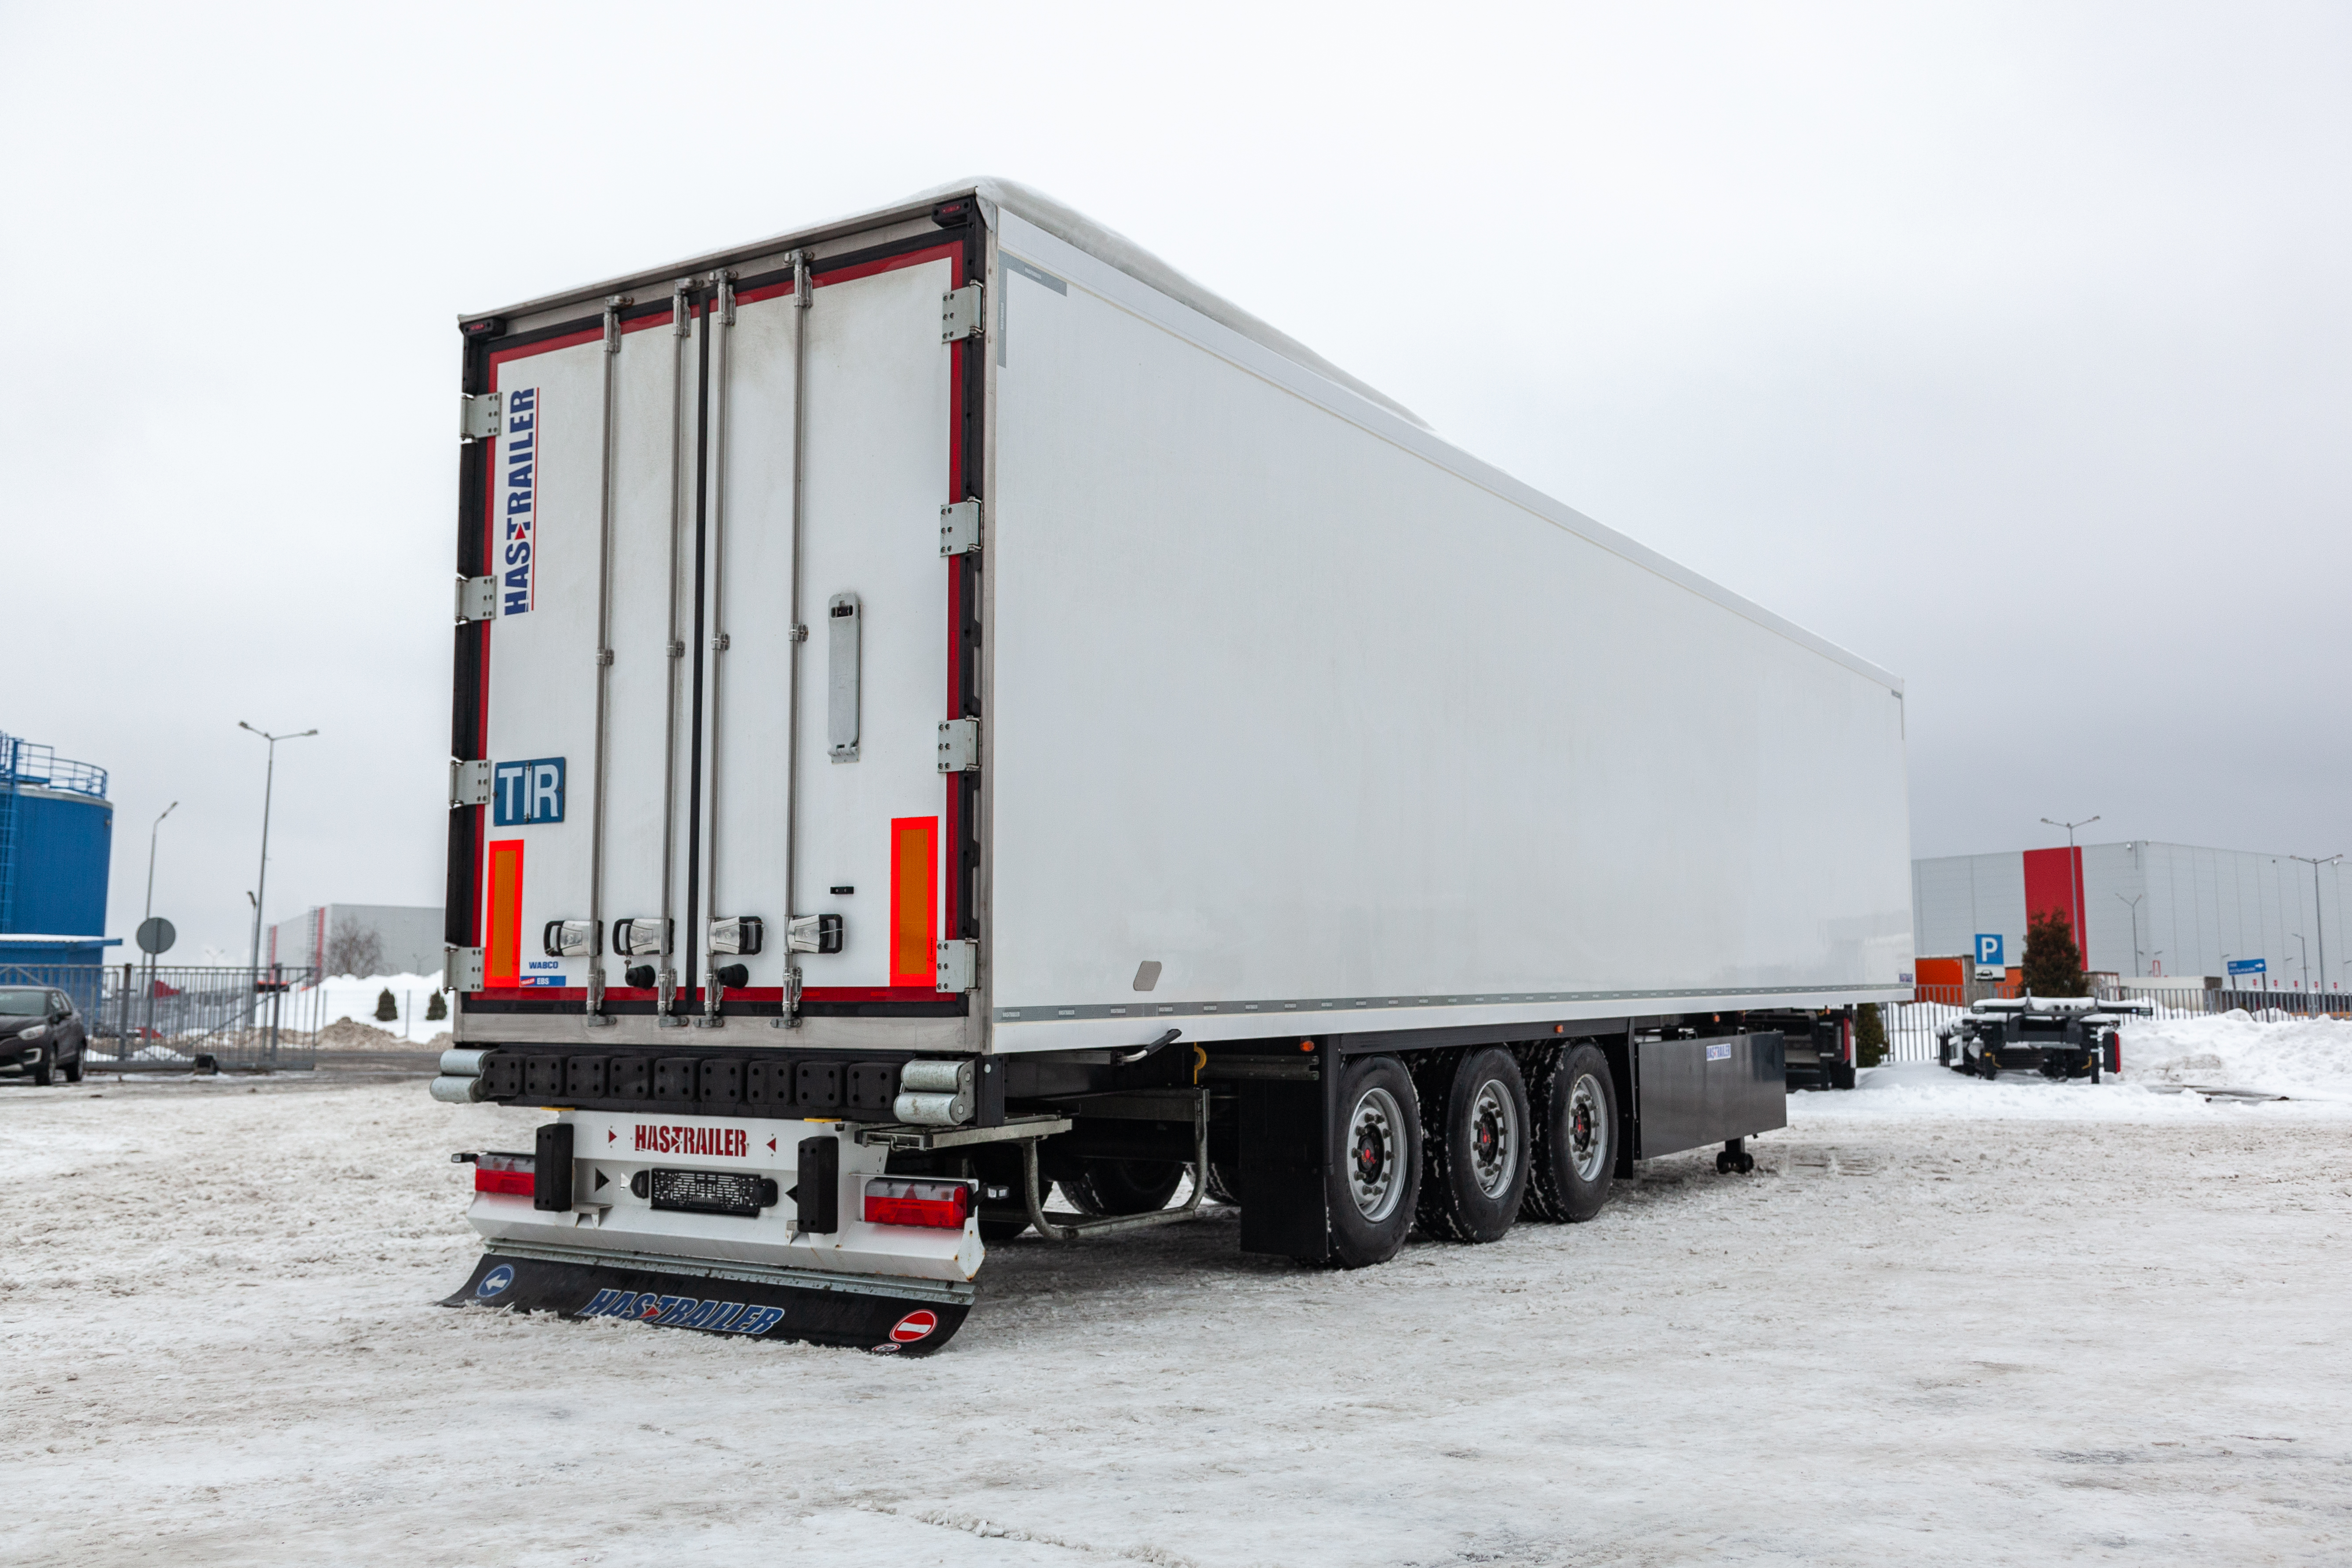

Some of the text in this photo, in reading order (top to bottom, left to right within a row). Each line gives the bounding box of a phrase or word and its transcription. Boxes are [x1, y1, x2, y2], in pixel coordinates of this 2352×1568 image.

[504, 387, 534, 615] HASTRAILER
[498, 764, 559, 820] TIR
[1981, 938, 1998, 962] P
[635, 1124, 746, 1157] HASTRAILER
[574, 1288, 785, 1335] HASTRAILER
